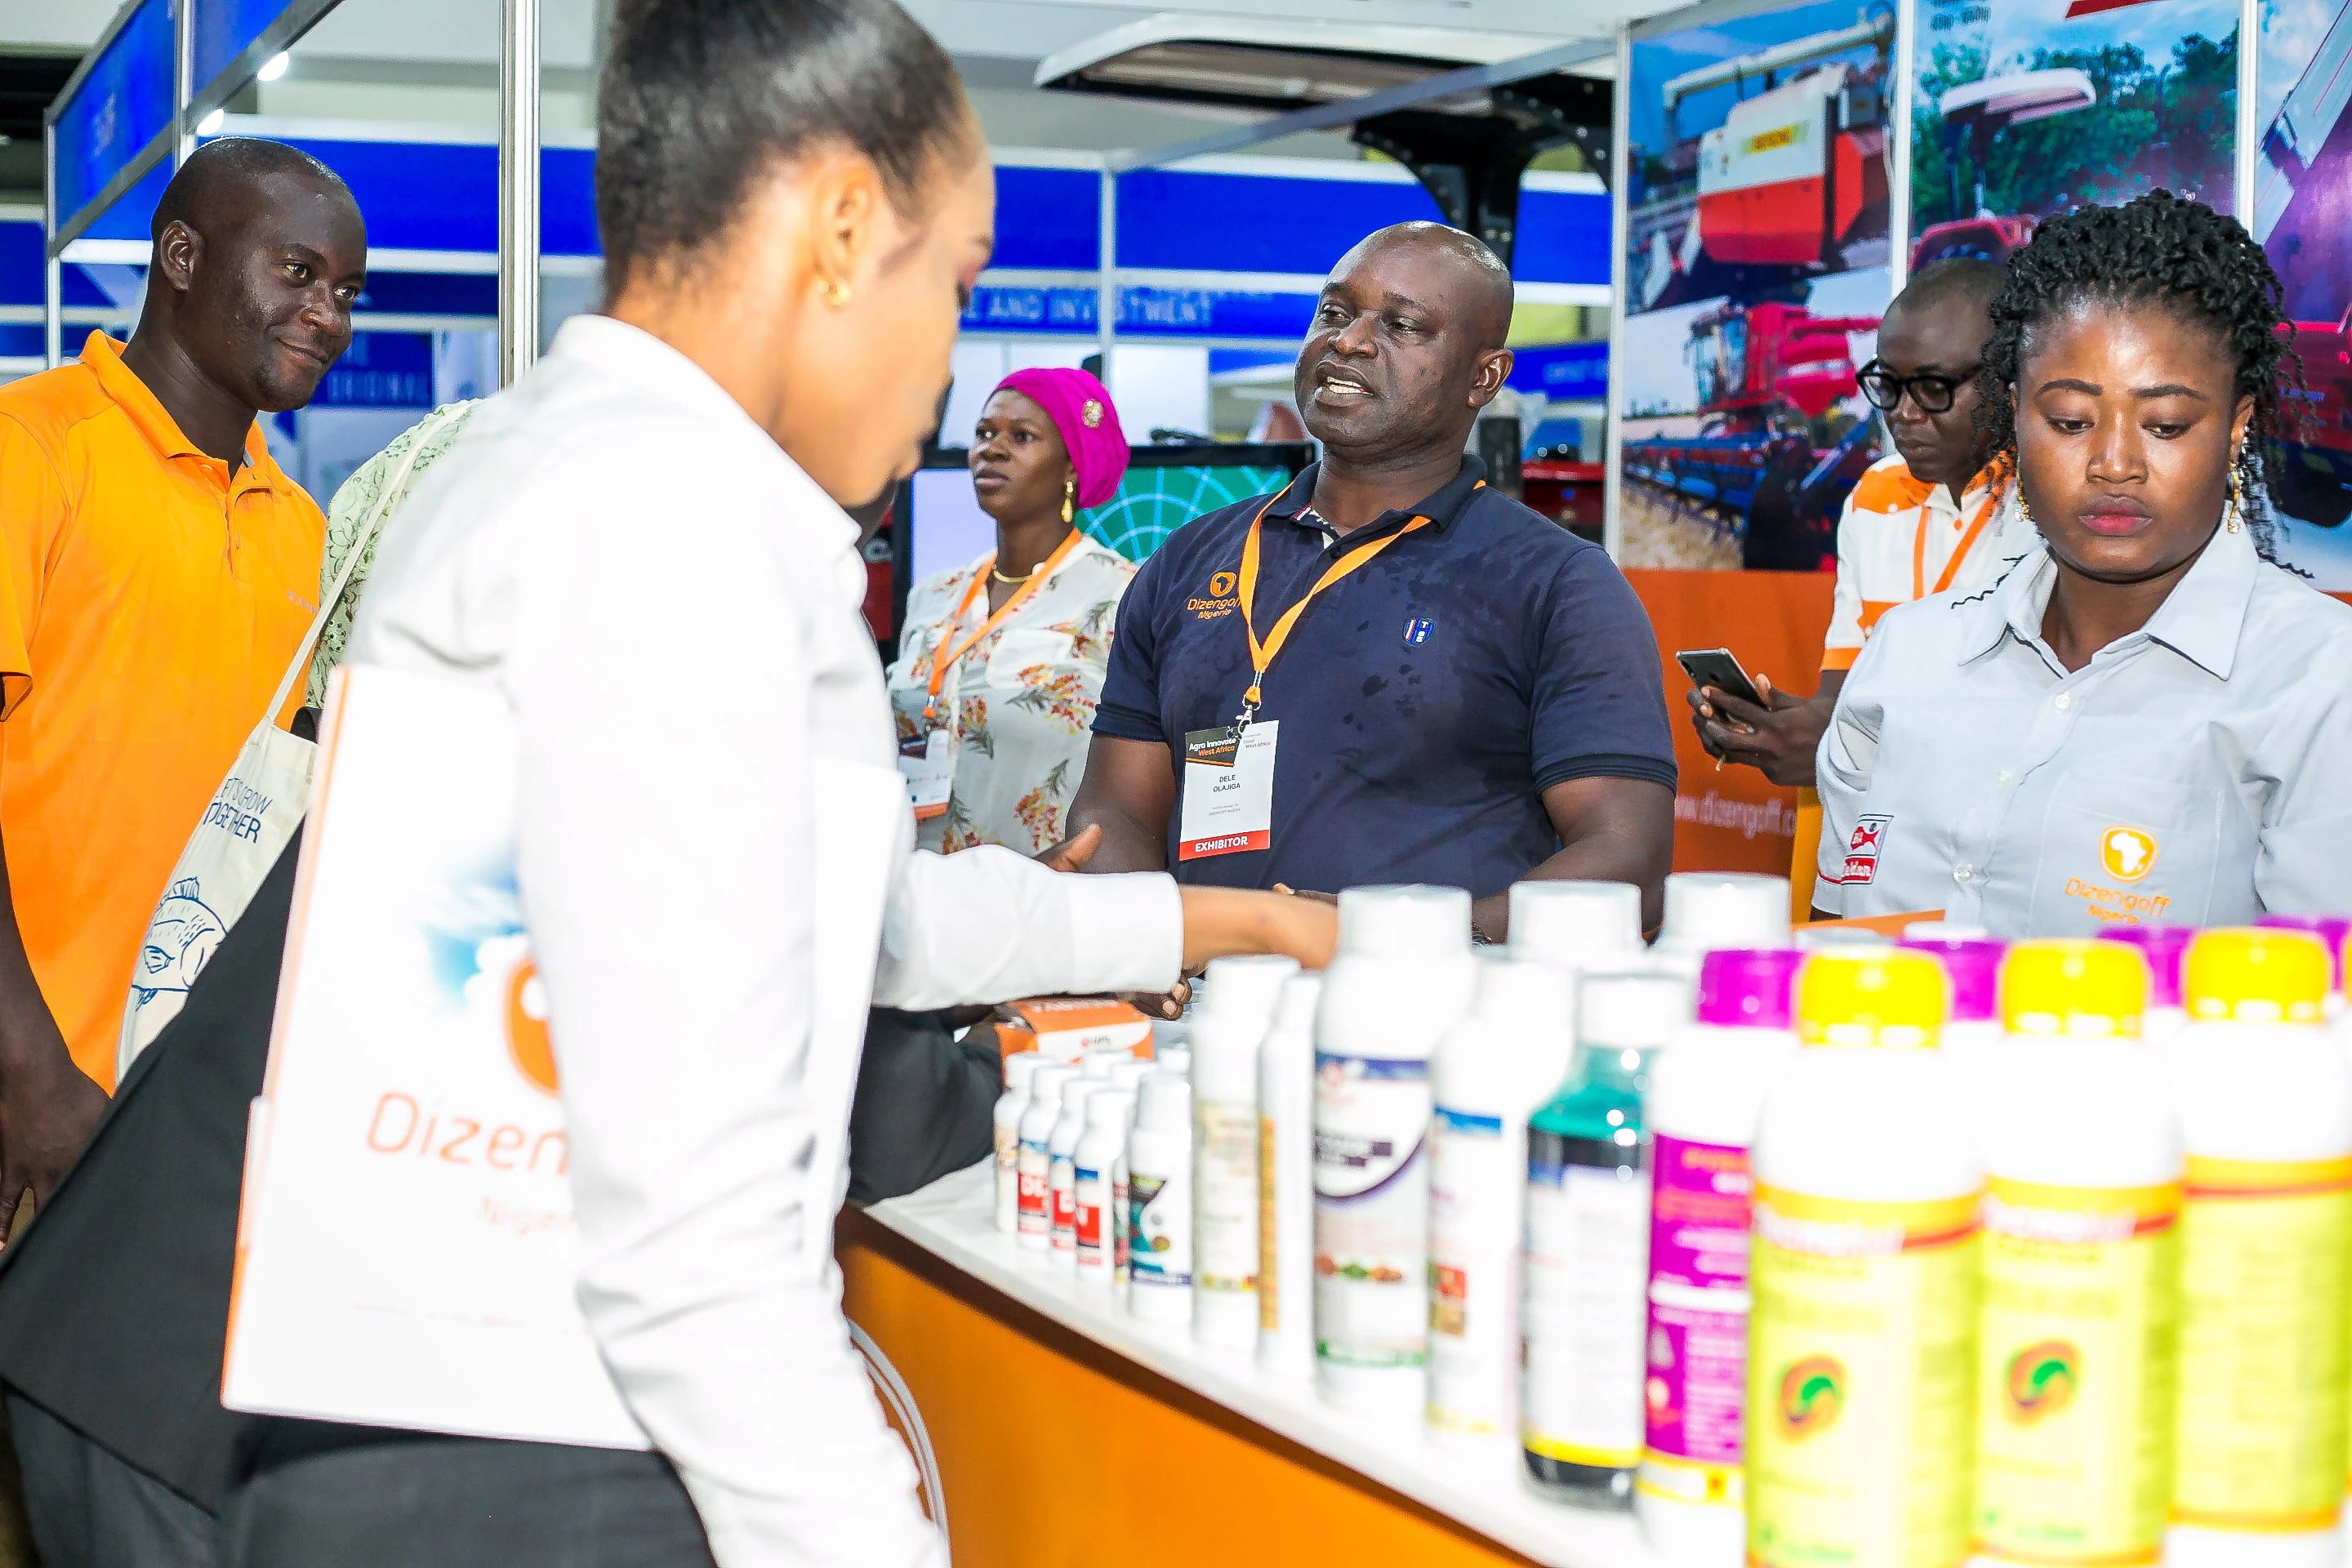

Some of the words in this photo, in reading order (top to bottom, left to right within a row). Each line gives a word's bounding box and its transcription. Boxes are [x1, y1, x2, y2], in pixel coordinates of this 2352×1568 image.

[1051, 289, 1212, 324] INVSTMENT
[1197, 608, 1232, 620] Nigeria
[1189, 742, 1206, 752] Agra
[1206, 737, 1236, 749] Innovate
[1197, 747, 1214, 757] West
[1215, 745, 1236, 754] Africa
[1219, 774, 1236, 783] DELE
[1213, 783, 1241, 792] OLAJIGA
[1195, 835, 1249, 853] EXHIBITOR
[2065, 877, 2172, 918] Dizengoff
[367, 1090, 569, 1177] Dizen
[478, 1196, 575, 1236] Nige
